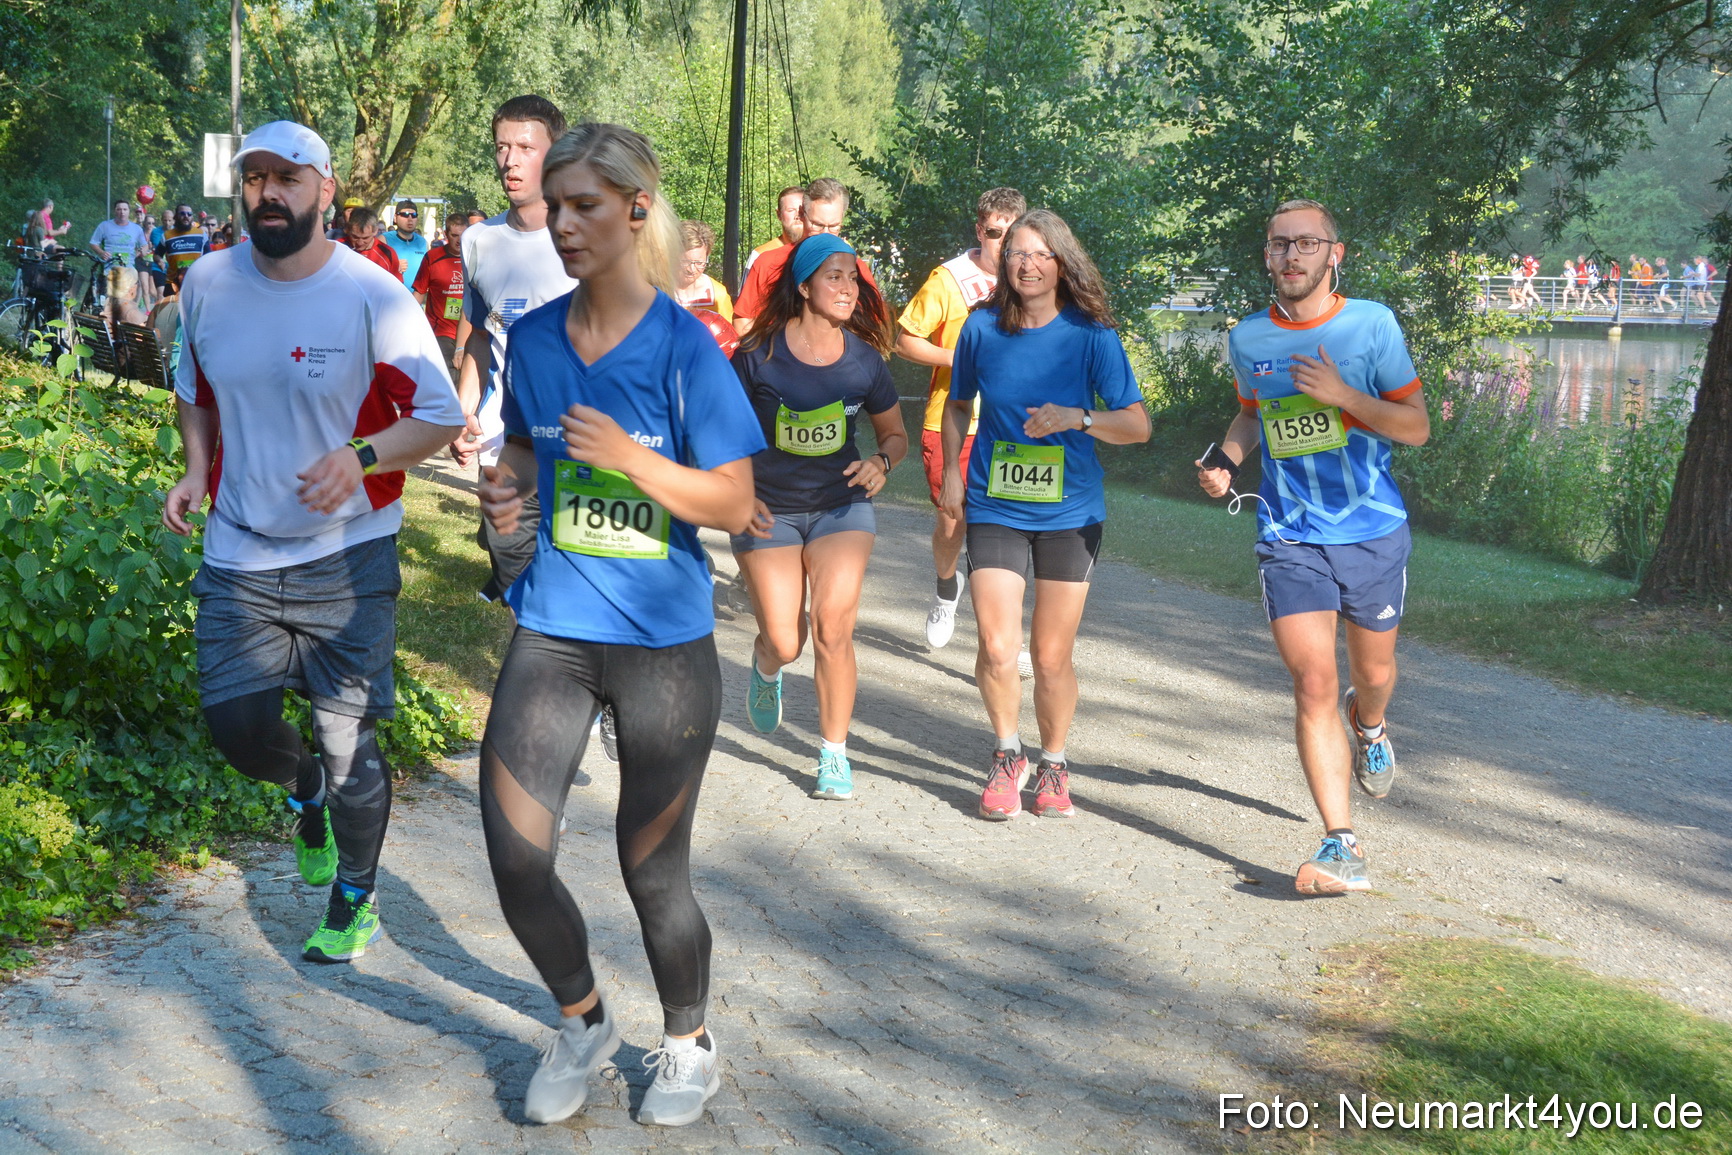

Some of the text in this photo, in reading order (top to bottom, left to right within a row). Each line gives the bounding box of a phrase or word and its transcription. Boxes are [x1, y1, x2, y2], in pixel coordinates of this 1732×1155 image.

[1338, 359, 1350, 367] eG
[307, 368, 325, 379] Karl
[784, 423, 837, 443] 1063
[1272, 412, 1330, 441] 1589
[1277, 433, 1333, 448] Schmid Maximilian
[999, 462, 1054, 486] 1044
[1003, 483, 1046, 493] Bittner Claudia
[567, 494, 654, 533] 1800
[584, 530, 631, 543] Maier Lisa
